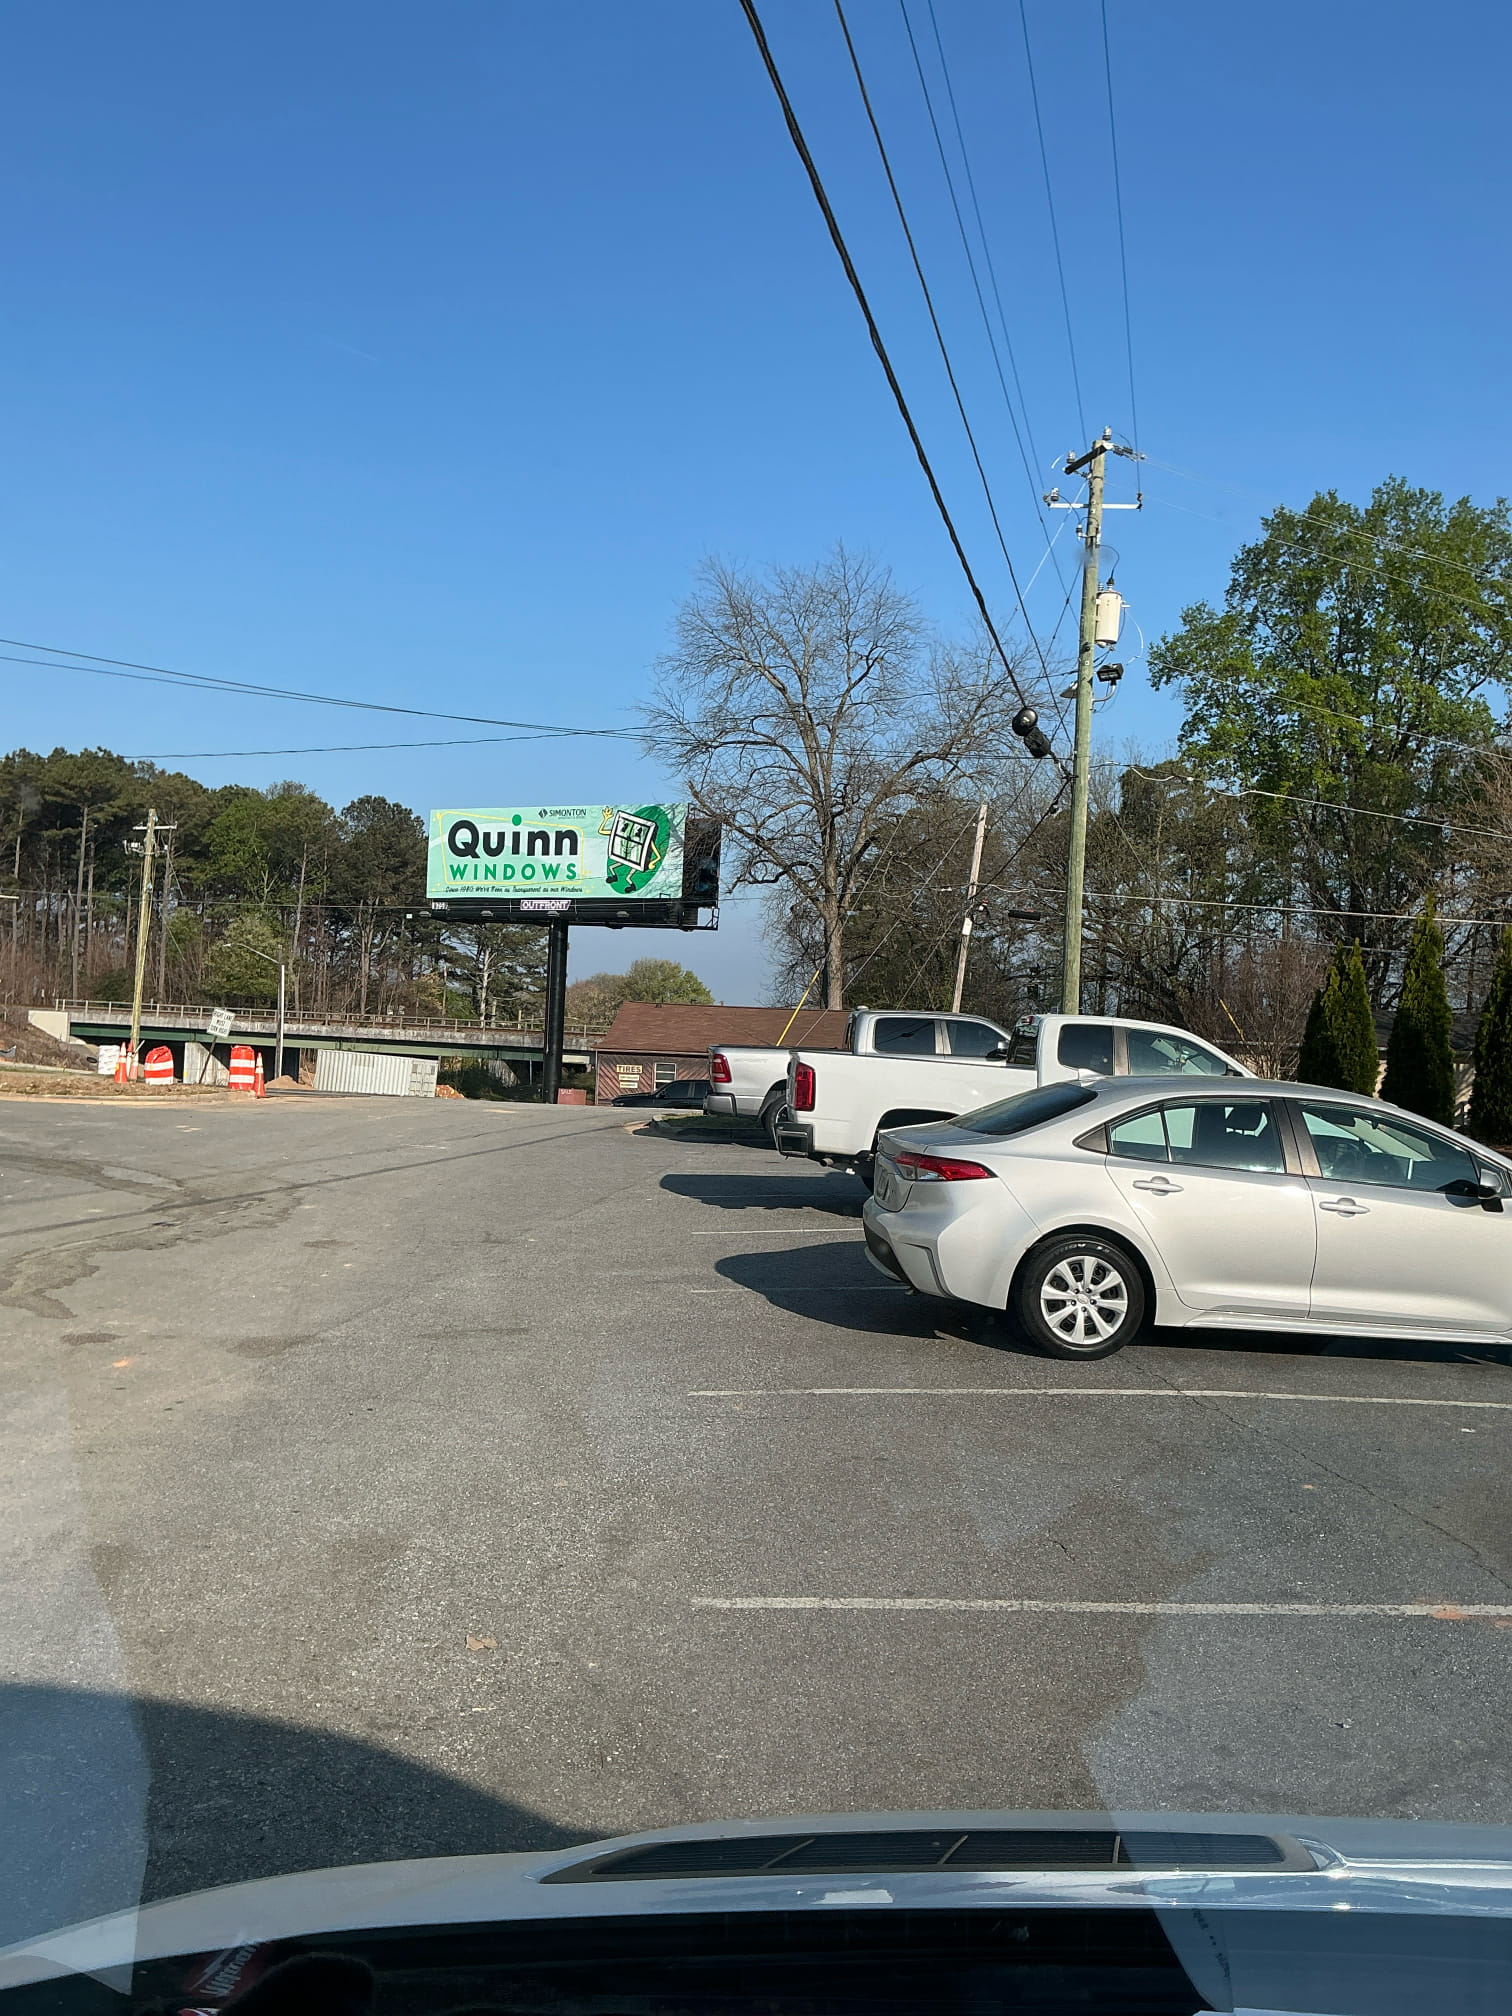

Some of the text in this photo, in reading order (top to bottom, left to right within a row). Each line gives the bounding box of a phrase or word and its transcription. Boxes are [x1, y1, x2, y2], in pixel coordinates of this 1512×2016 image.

[448, 814, 578, 858] Quinn
[450, 863, 577, 881] WINDOWS
[522, 901, 568, 910] OUTFRONT
[617, 1065, 641, 1073] TIRES
